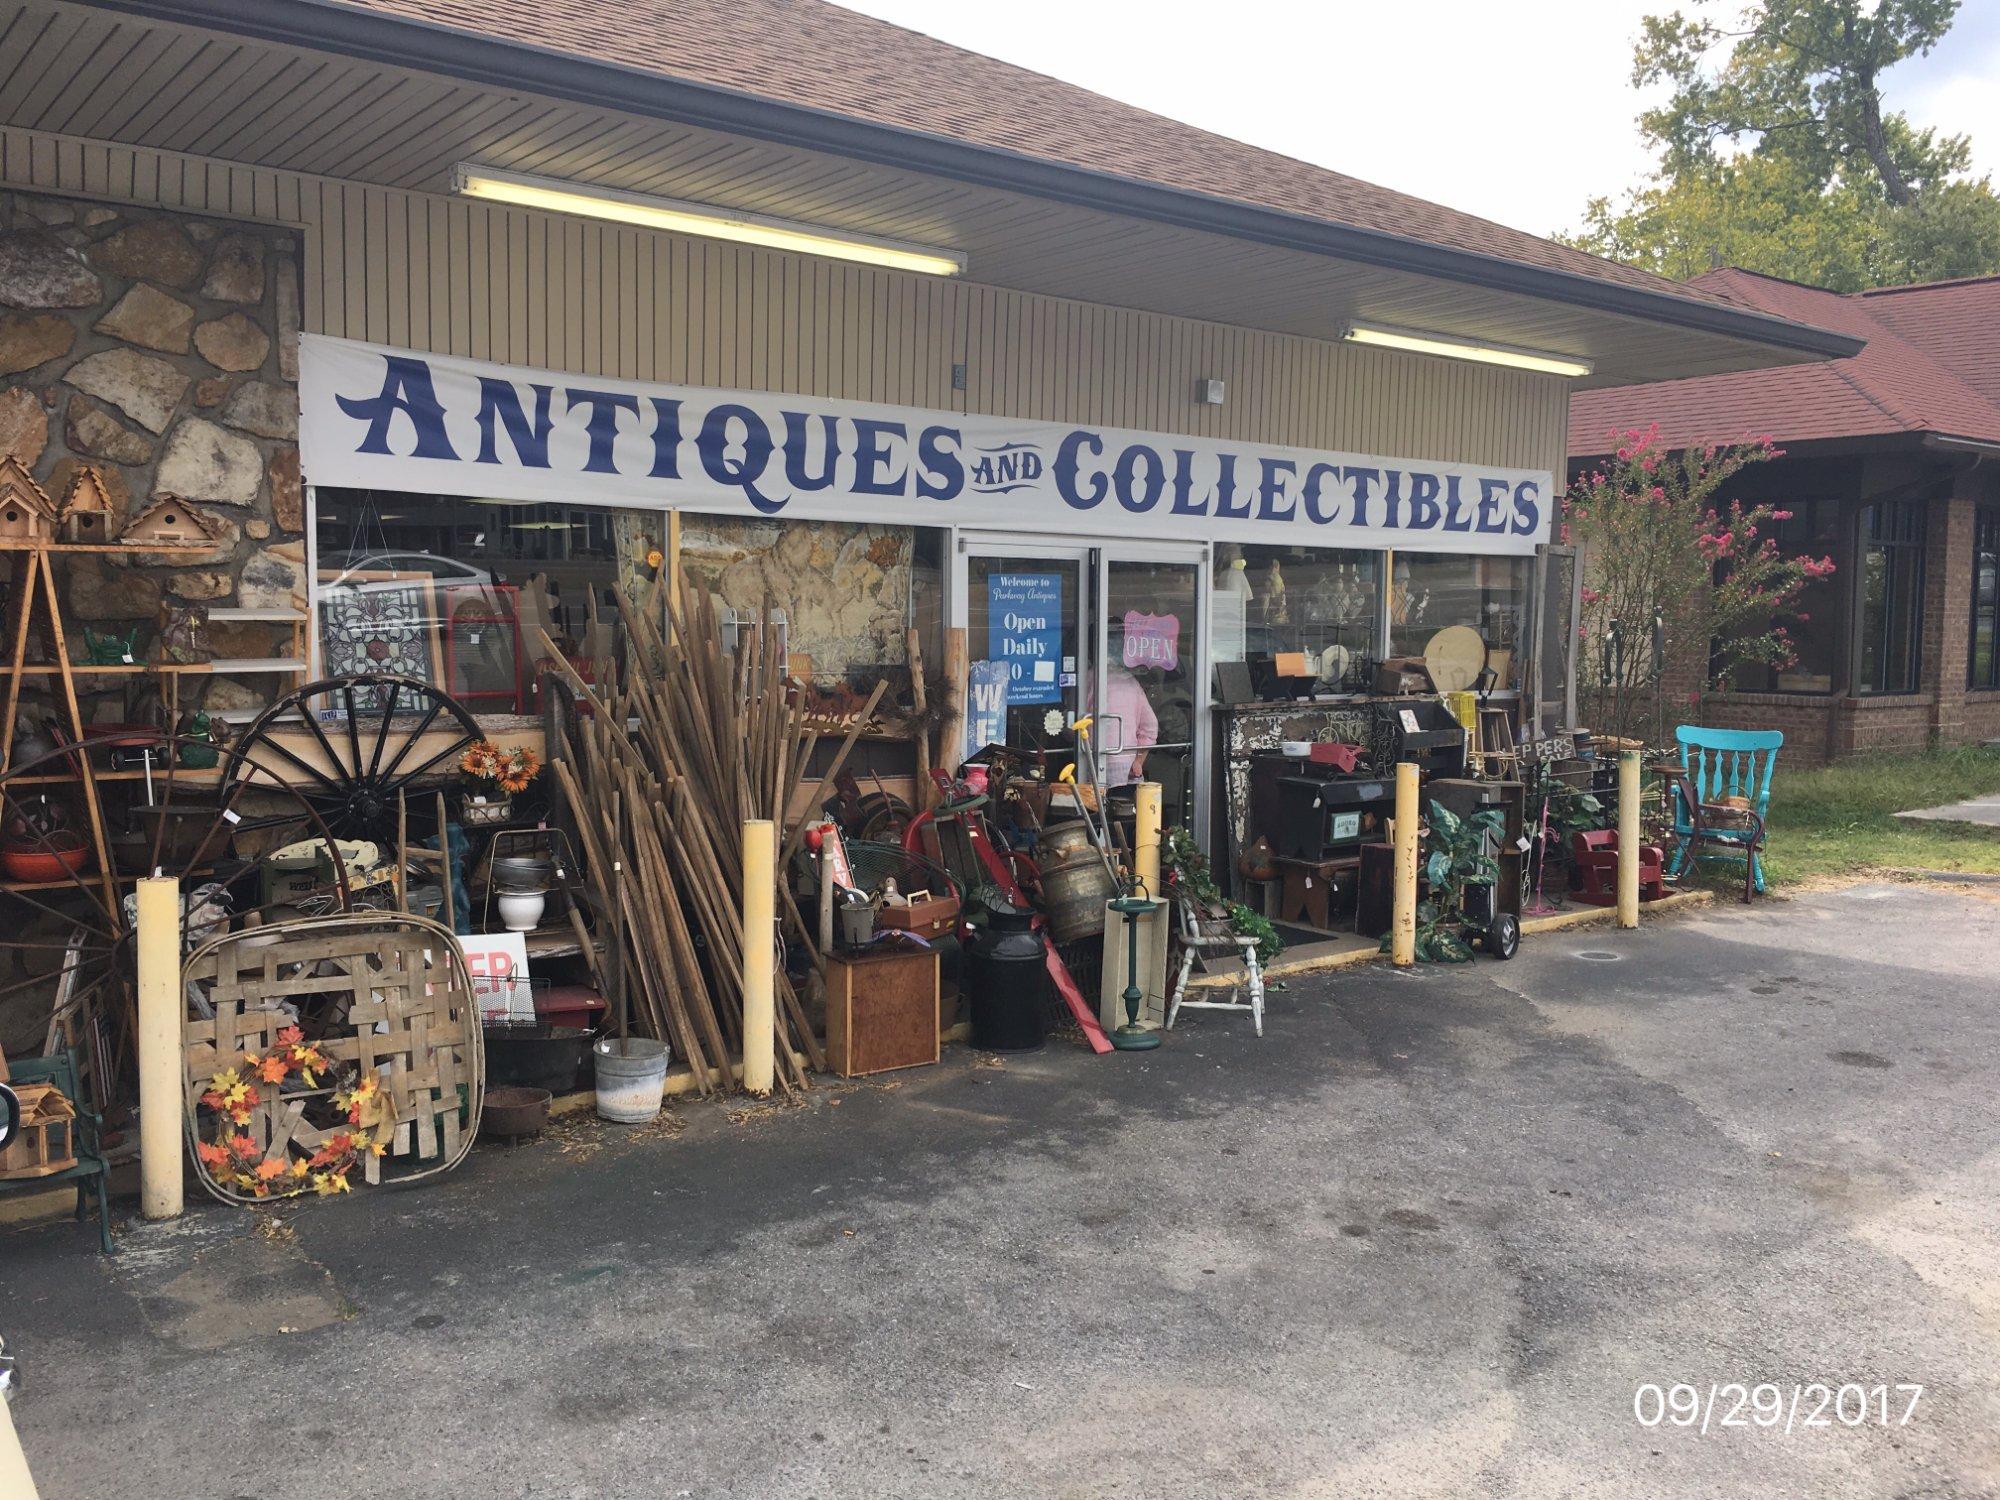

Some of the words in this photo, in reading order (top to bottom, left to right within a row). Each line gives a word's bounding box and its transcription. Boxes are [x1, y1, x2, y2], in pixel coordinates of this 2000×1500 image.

[334, 354, 966, 515] ANTIQUES
[971, 449, 1042, 486] AND
[1052, 430, 1539, 537] COLLECTIBLES
[1000, 576, 1039, 587] Welcome
[1040, 577, 1050, 587] to
[992, 587, 1026, 604] Parkway
[1027, 587, 1057, 604] Antiques
[1003, 611, 1047, 634] Open
[1002, 637, 1048, 658] Daily
[1126, 635, 1174, 661] OPEN
